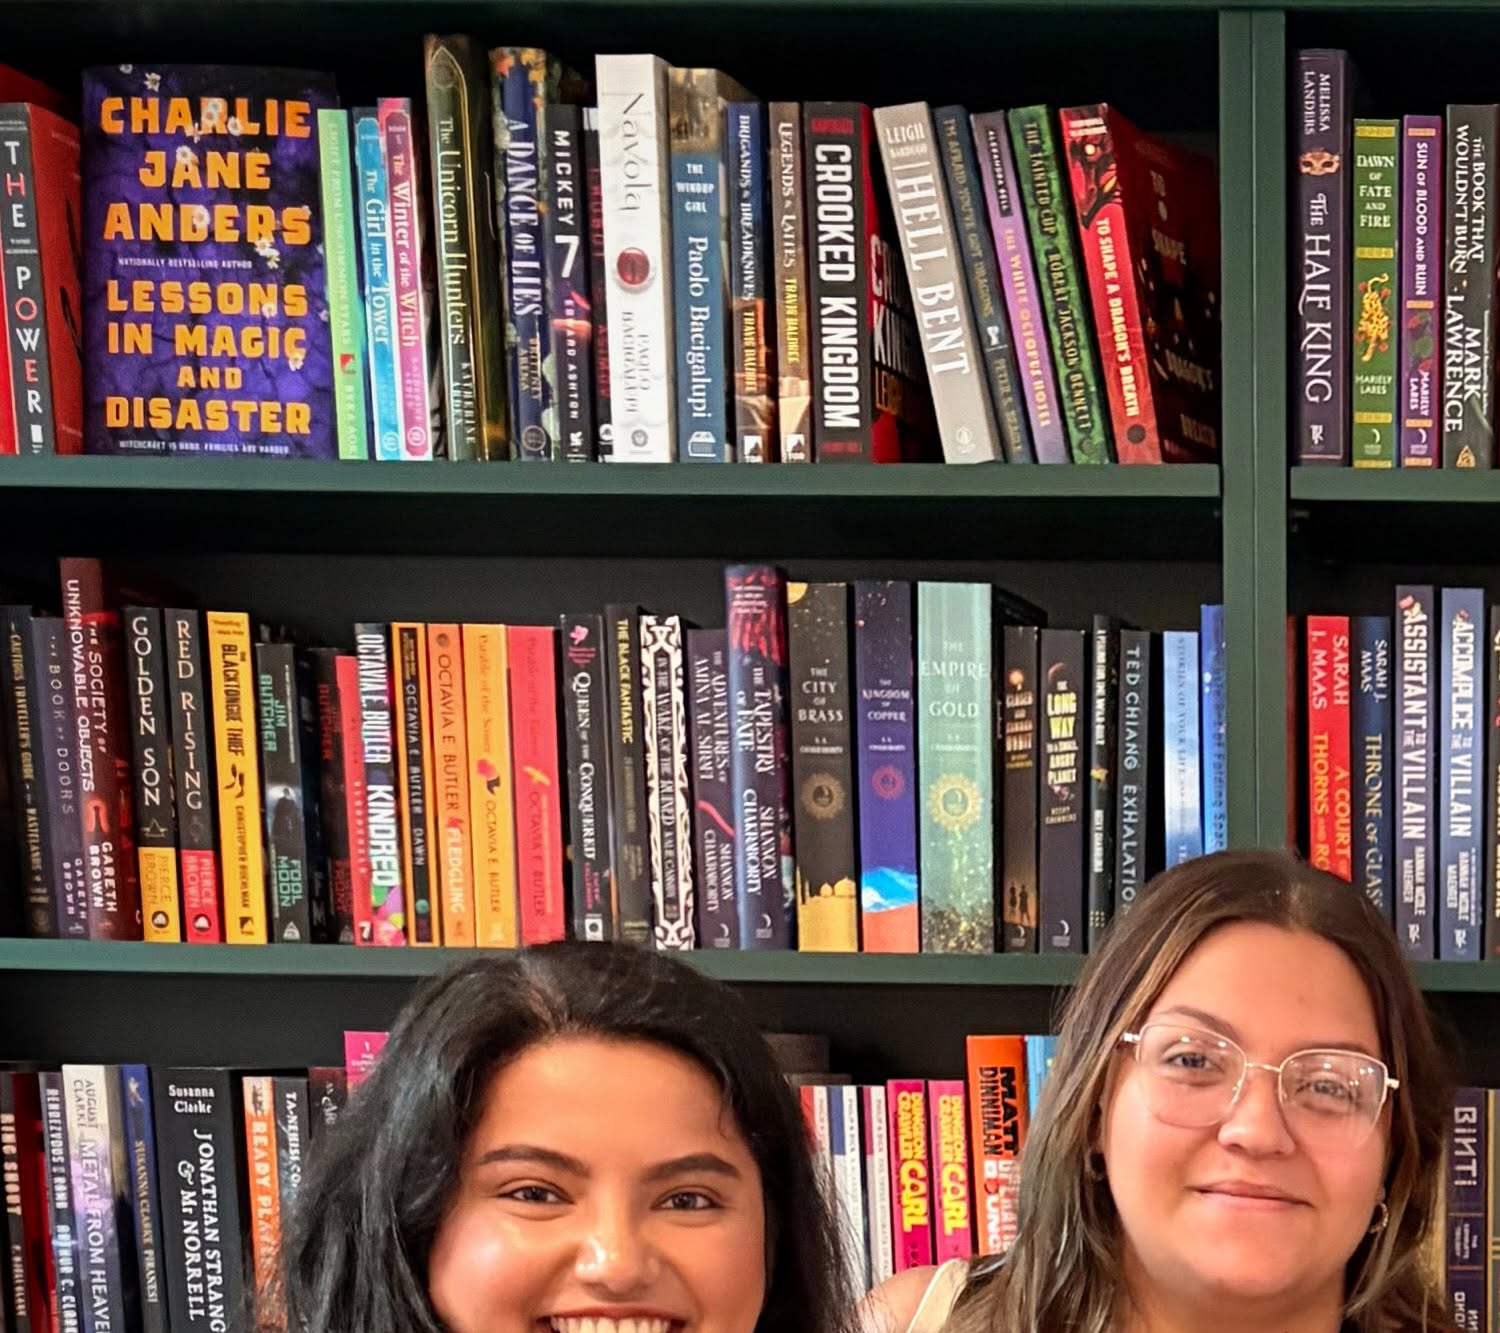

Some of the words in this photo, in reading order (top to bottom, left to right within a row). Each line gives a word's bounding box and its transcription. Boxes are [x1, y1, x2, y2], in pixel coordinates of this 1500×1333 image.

[100, 96, 311, 138] CHARLIE
[4, 141, 26, 228] THE
[138, 151, 270, 189] JANE
[554, 130, 573, 226] MICKEY
[613, 93, 653, 213] Navola
[686, 163, 703, 174] THE
[1356, 156, 1395, 168] DAWN
[438, 151, 460, 252] Unicorn
[675, 182, 714, 194] WINDUP
[685, 201, 707, 213] GIRL
[814, 144, 856, 283] CROOKED
[103, 203, 311, 245] ANDERS
[895, 172, 948, 272] HELL
[1360, 215, 1391, 228] FIRE
[221, 258, 253, 269] AUTHOR
[554, 235, 580, 279] 7
[688, 237, 708, 298] Paolo
[1299, 234, 1331, 316] HALF
[106, 280, 308, 316] LESSONS
[448, 254, 467, 346] Hunters
[916, 280, 971, 376] BENT
[14, 266, 44, 414] POWER
[108, 322, 152, 354] IN
[174, 323, 307, 358] MAGIC
[686, 305, 712, 418] Bacigalupi
[820, 296, 861, 428] KINGDOM
[1301, 321, 1332, 404] KING
[176, 366, 242, 390] AND
[105, 397, 311, 434] DISASTER
[132, 616, 155, 735] GOLDEN
[177, 620, 194, 679] RED
[920, 662, 989, 677] EMPIRE
[1126, 646, 1140, 686] TED
[1451, 612, 1473, 730] ACCOMPLICE
[67, 579, 88, 706] UNKNOWABLE
[79, 714, 95, 793] OBJECTS
[799, 709, 843, 723] BRASS
[803, 681, 837, 694] CITY
[928, 702, 978, 717] GOLD
[182, 694, 201, 810] RISING
[1124, 696, 1139, 771] CHIANG
[143, 748, 160, 806] SON
[1451, 757, 1471, 837] VILLAIN
[367, 784, 399, 887] KINDRED
[168, 1085, 215, 1098] Susanna
[175, 1100, 212, 1113] Clarke
[979, 1067, 1002, 1156] DINNIMAN
[1000, 1067, 1018, 1155] MATT
[253, 1121, 271, 1183] READY
[898, 1091, 913, 1160] CRAWLER
[911, 1093, 928, 1157] DUNGEON
[180, 1189, 197, 1214] Mr
[194, 1129, 219, 1242] JONATHAN
[900, 1162, 929, 1232] CARL
[183, 1219, 204, 1321] NORRELL
